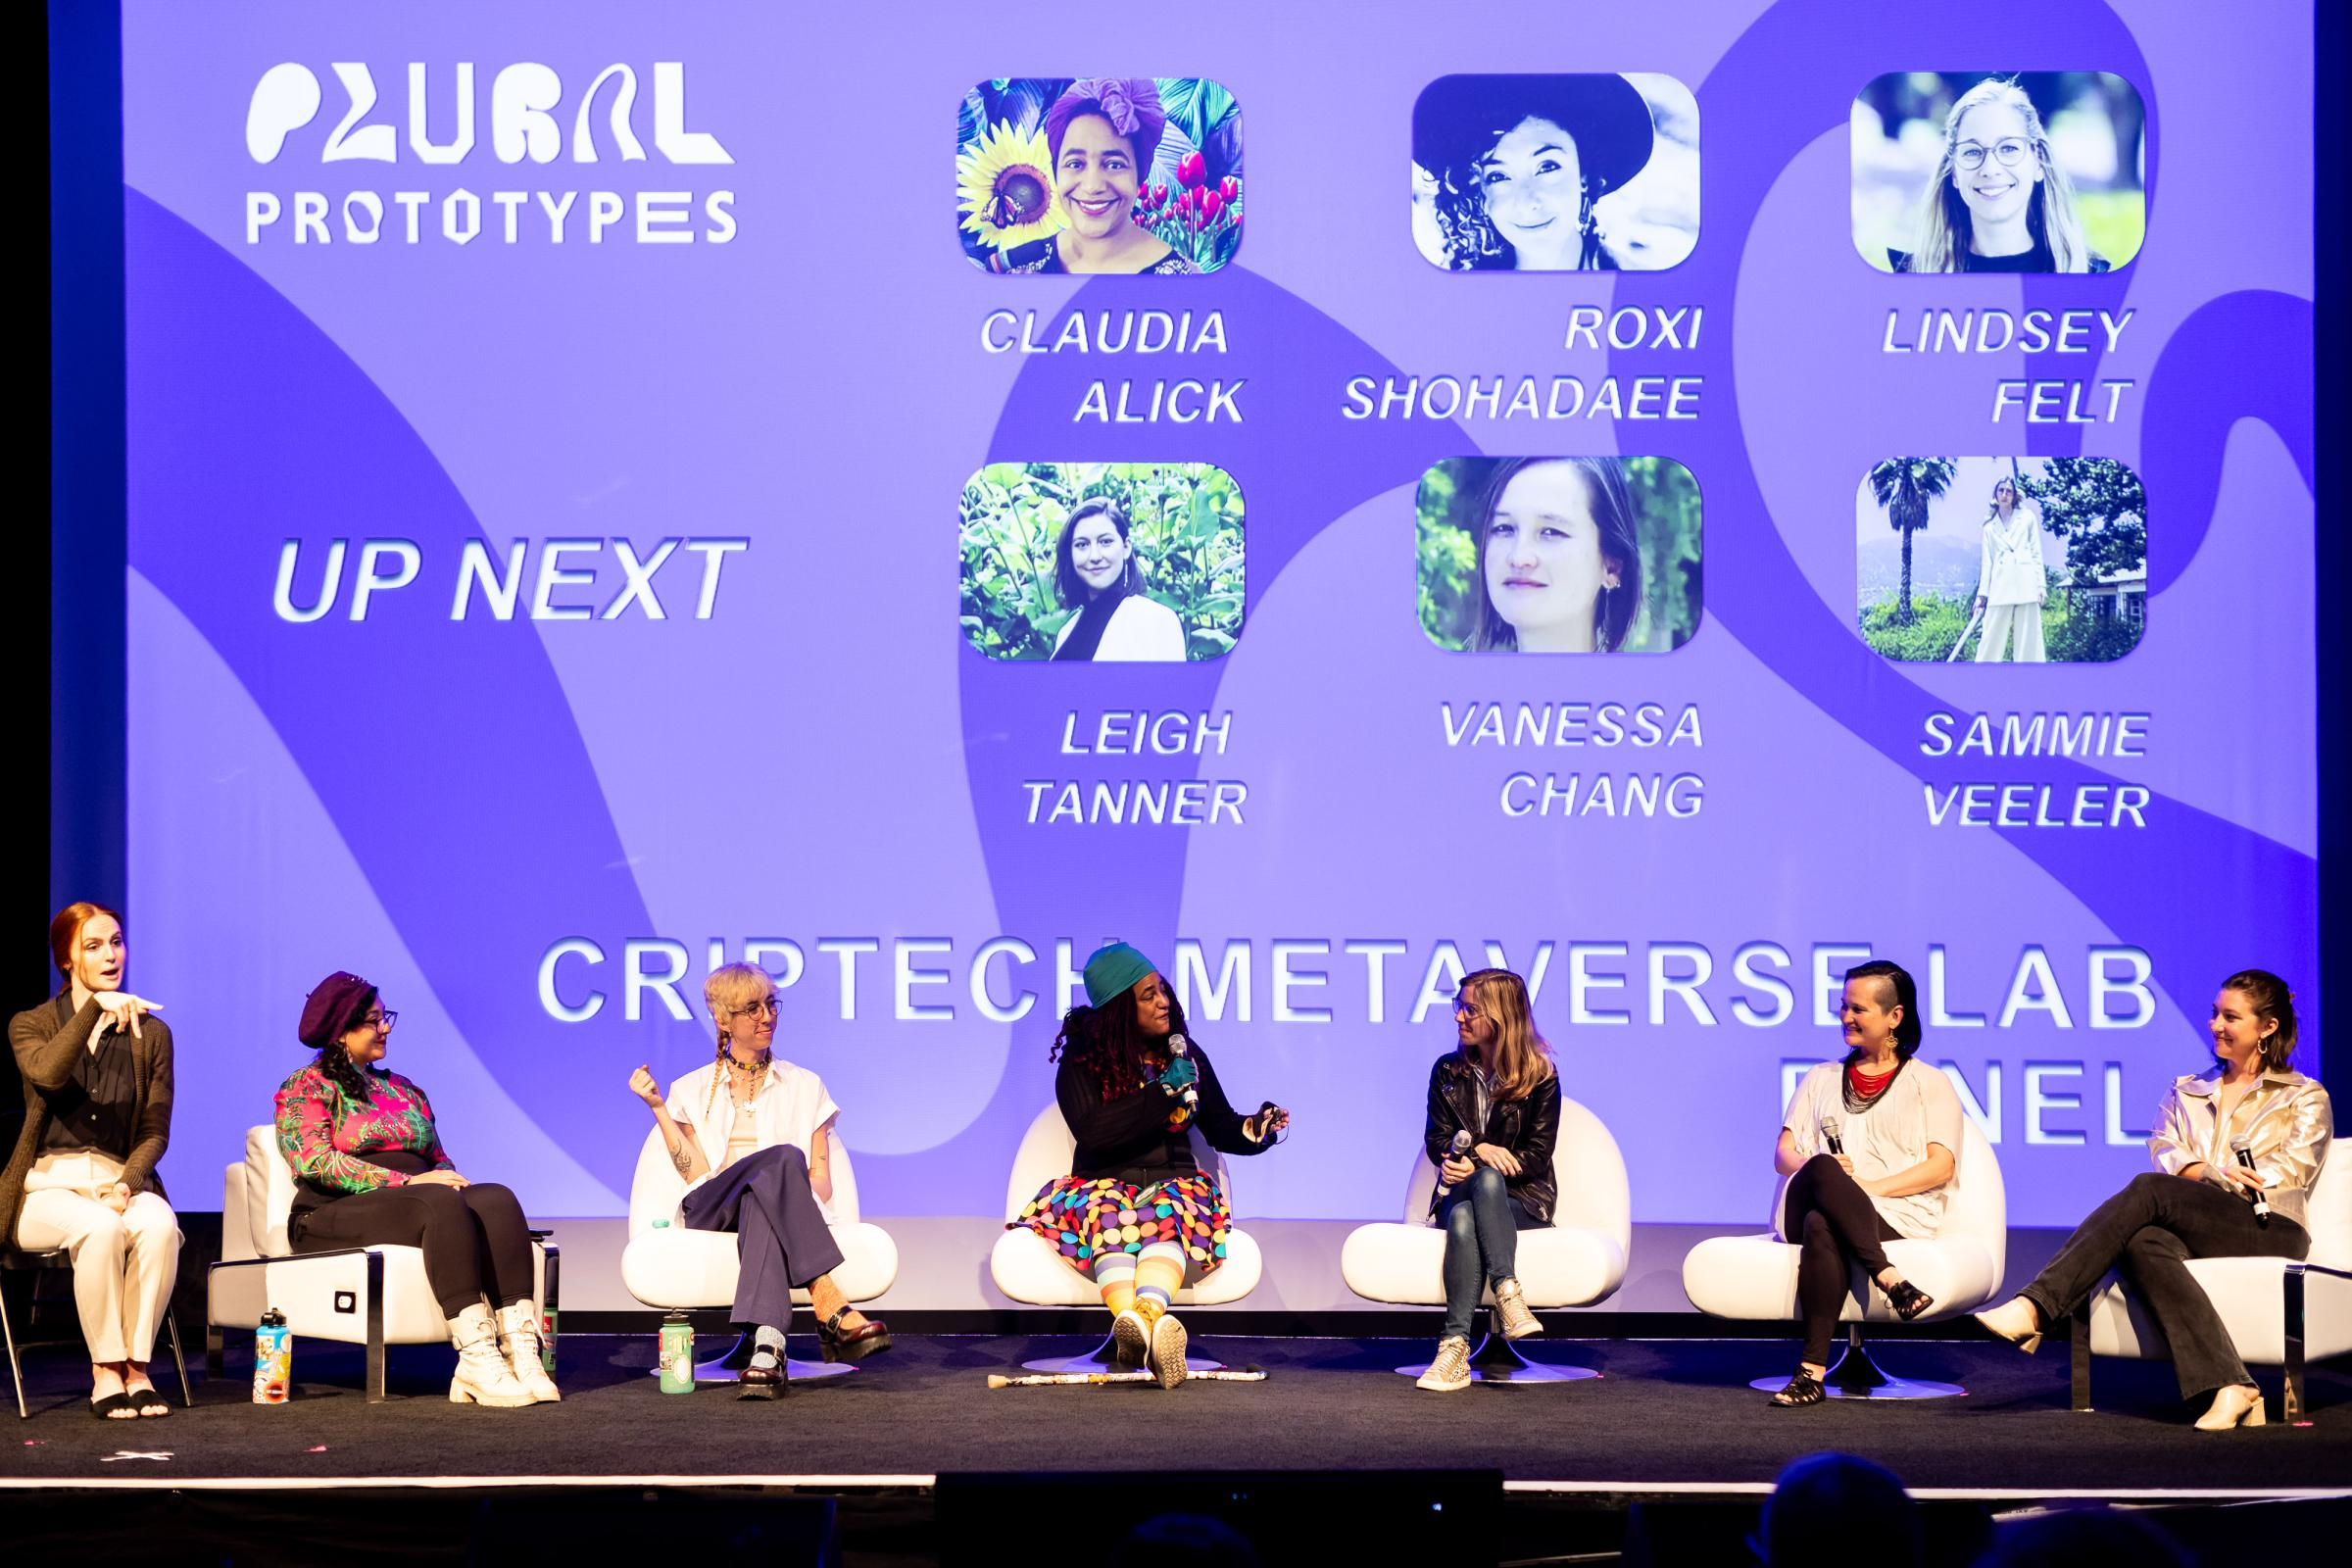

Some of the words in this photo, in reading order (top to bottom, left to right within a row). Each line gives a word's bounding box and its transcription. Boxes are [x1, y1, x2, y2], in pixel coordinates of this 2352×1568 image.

[246, 62, 736, 165] PLURAL
[246, 187, 738, 245] PROTOTYPES
[980, 310, 1228, 354] CLAUDIA
[1565, 306, 1703, 350] ROXI
[1882, 309, 2134, 354] LINDSEY
[1073, 378, 1247, 423] ALICK
[1342, 376, 1702, 420] SHOHADAEE
[1991, 379, 2134, 423] FELT
[272, 537, 421, 622] UP
[450, 537, 750, 620] NEXT
[1060, 710, 1233, 756] LEIGH
[1441, 703, 1704, 747] VANESSA
[1920, 711, 2151, 757] SAMMIE
[1023, 780, 1249, 825] TANNER
[1499, 772, 1704, 818] CHANG
[1923, 783, 2151, 828] VEELER
[1175, 938, 1872, 1027] METAVERSE
[1929, 943, 2157, 1029] LAB
[1781, 1057, 2151, 1147] NEL
